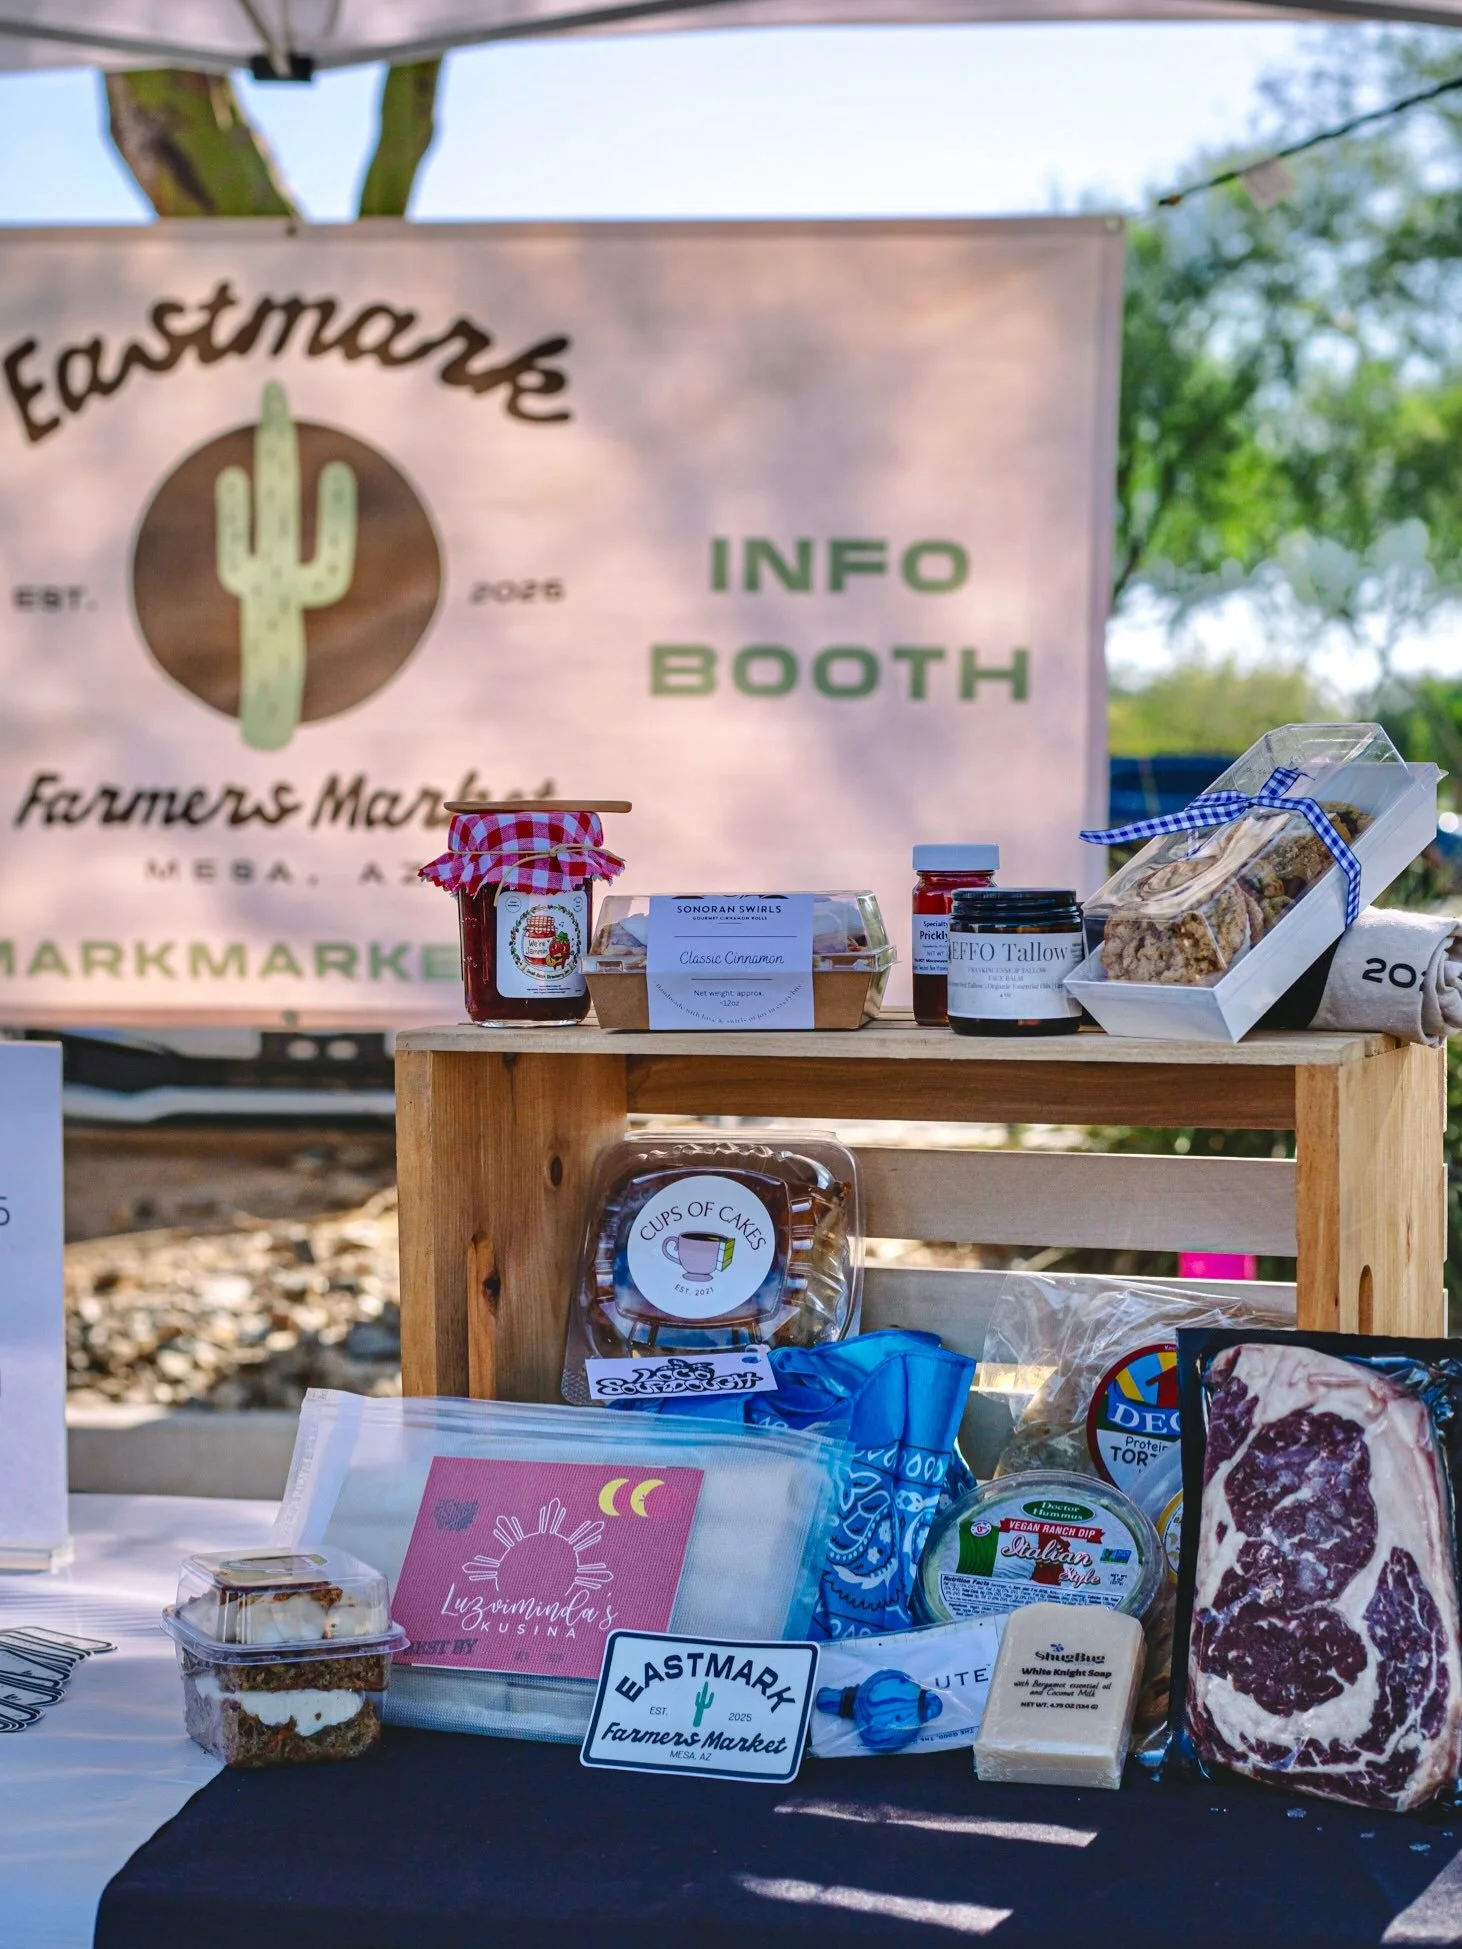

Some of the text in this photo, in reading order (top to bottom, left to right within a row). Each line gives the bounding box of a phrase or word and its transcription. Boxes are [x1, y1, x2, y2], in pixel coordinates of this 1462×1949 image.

[3, 279, 573, 447] Eastmark
[710, 536, 971, 595] INFO
[13, 583, 99, 614] EST.
[468, 578, 567, 607] 2025
[649, 643, 1031, 703] BOOTH
[13, 769, 303, 832] Farmers
[144, 857, 321, 888] MESA,
[677, 905, 782, 914] SONORAN SWIRLS
[923, 920, 949, 929] Specialty
[919, 930, 948, 943] Prickly
[679, 950, 785, 965] Classic Cinnamon
[1002, 941, 1067, 962] Tallow
[1362, 956, 1427, 992] 20
[708, 990, 735, 998] weight:
[640, 1201, 767, 1251] CUPS OF CAKES
[674, 1283, 692, 1295] EST.
[1033, 1508, 1083, 1521] Hummus
[1041, 1501, 1080, 1512] Doctor
[1009, 1520, 1096, 1538] VEGAN RANCH DIP
[1001, 1533, 1093, 1567] Italian
[1058, 1564, 1101, 1588] Style
[441, 1583, 617, 1631] Luzviminda's
[481, 1622, 576, 1639] KUSINA
[1035, 1651, 1105, 1664] ShugBug
[1021, 1667, 1113, 1679] White Knight Soap
[614, 1652, 796, 1713] EASTMARK
[1013, 1679, 1113, 1690] with Bergamot essential oil
[1029, 1687, 1096, 1698] and Coconut Milk
[649, 1706, 752, 1722] EST. 2025
[601, 1721, 788, 1755] Farmers Market
[669, 1749, 712, 1762] MESA, AZ
